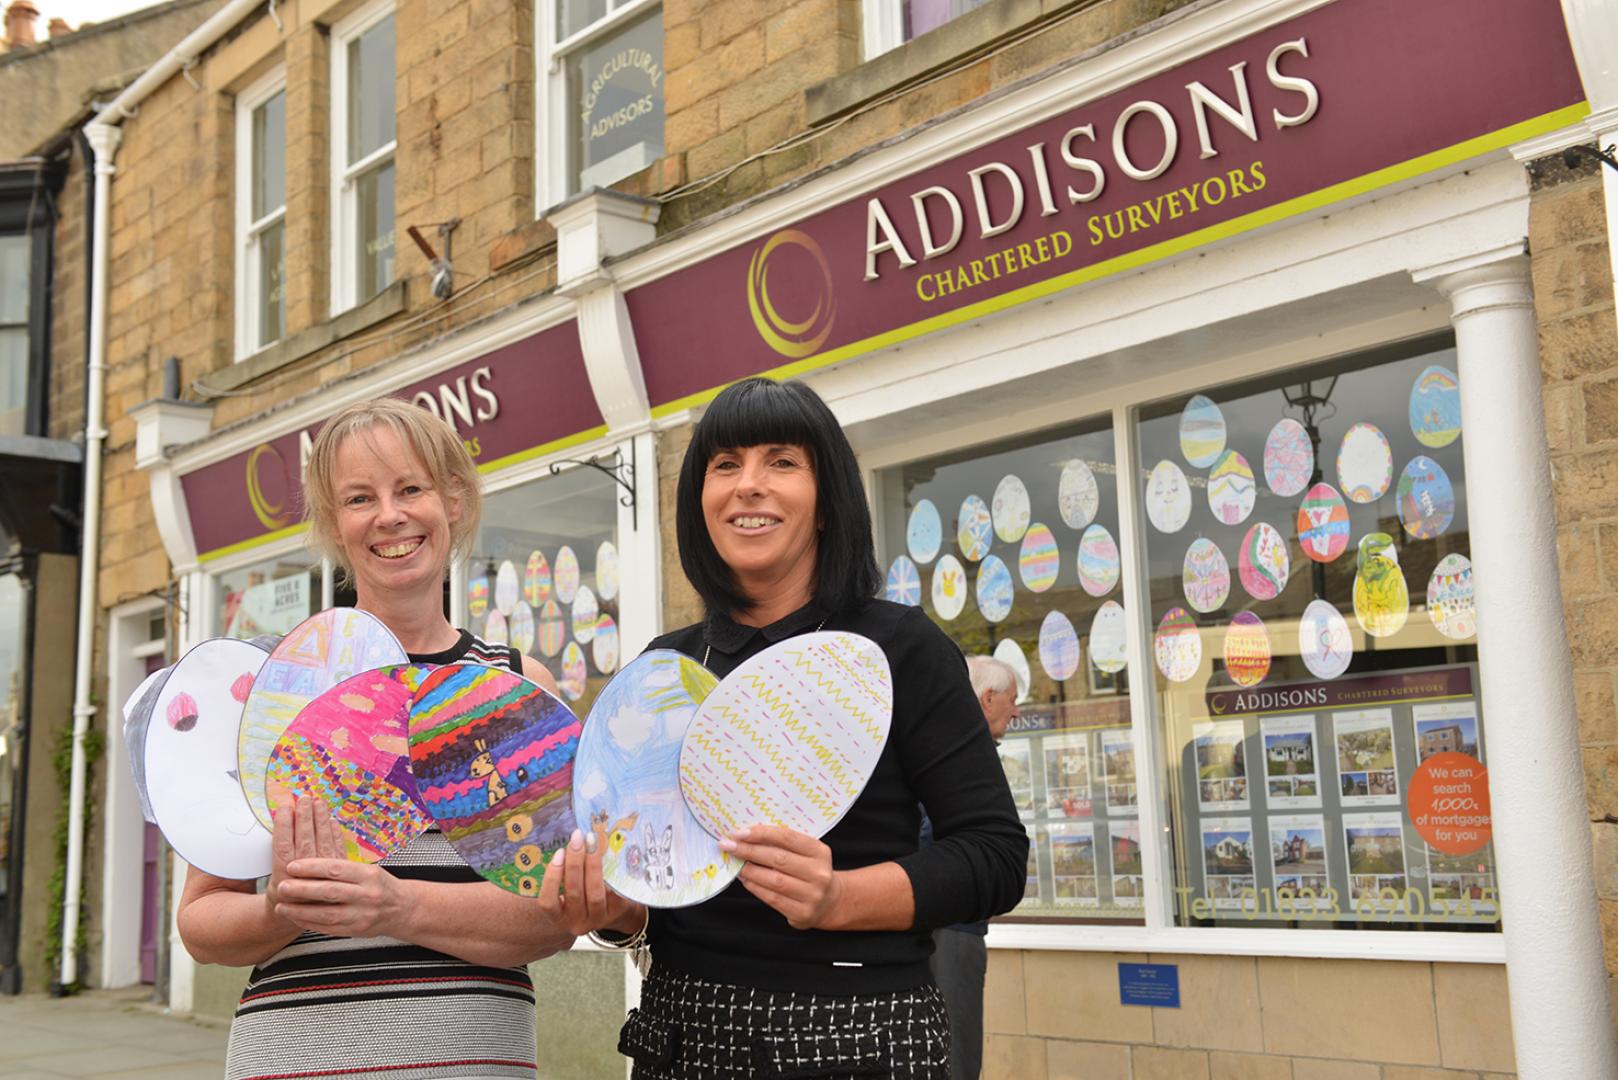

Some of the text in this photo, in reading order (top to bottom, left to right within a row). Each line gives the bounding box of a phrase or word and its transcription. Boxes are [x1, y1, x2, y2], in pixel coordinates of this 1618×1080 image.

[581, 48, 662, 124] AGRICULTURAL
[589, 94, 654, 140] ADVISORS
[863, 37, 1319, 282] ADDISONS
[916, 160, 1267, 301] CHARTERED SURVEYORS
[1235, 687, 1328, 711] ADDISONS
[1428, 767, 1473, 778] We can
[1433, 783, 1472, 794] search
[1416, 813, 1428, 825] of
[1435, 829, 1478, 842] for you
[1241, 887, 1341, 921] 01833
[1356, 886, 1501, 923] 690545
